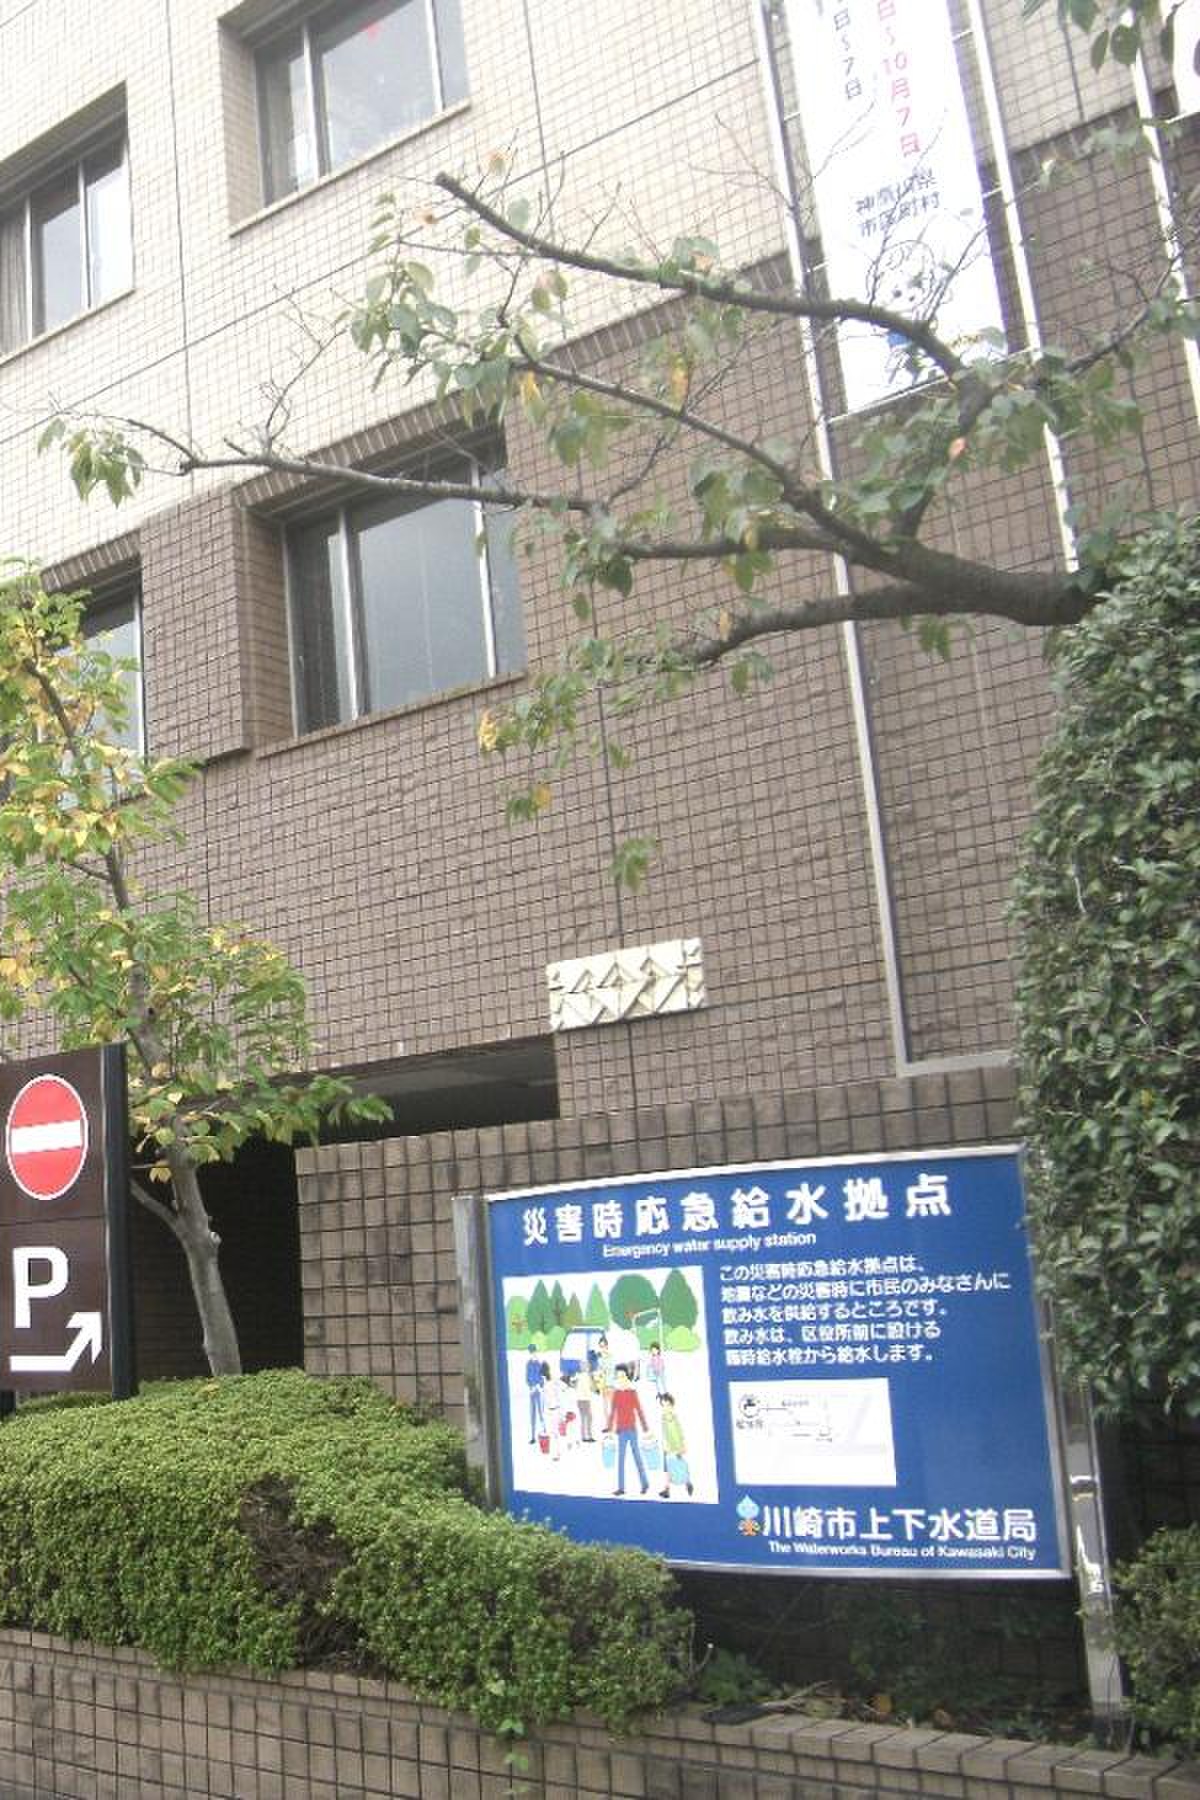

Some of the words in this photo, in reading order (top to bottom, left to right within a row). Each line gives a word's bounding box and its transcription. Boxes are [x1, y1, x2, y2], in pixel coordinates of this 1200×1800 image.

[522, 1172, 952, 1247] 災害時応急給水拠点
[602, 1242, 670, 1259] Emergency
[672, 1239, 711, 1253] water
[713, 1234, 762, 1253] supply
[764, 1232, 817, 1247] station
[12, 1246, 69, 1329] P
[762, 1505, 1037, 1541] 川崎市上下水道局
[768, 1540, 792, 1553] The
[870, 1543, 918, 1557] Bureau
[920, 1545, 935, 1557] of
[1007, 1545, 1036, 1561] City
